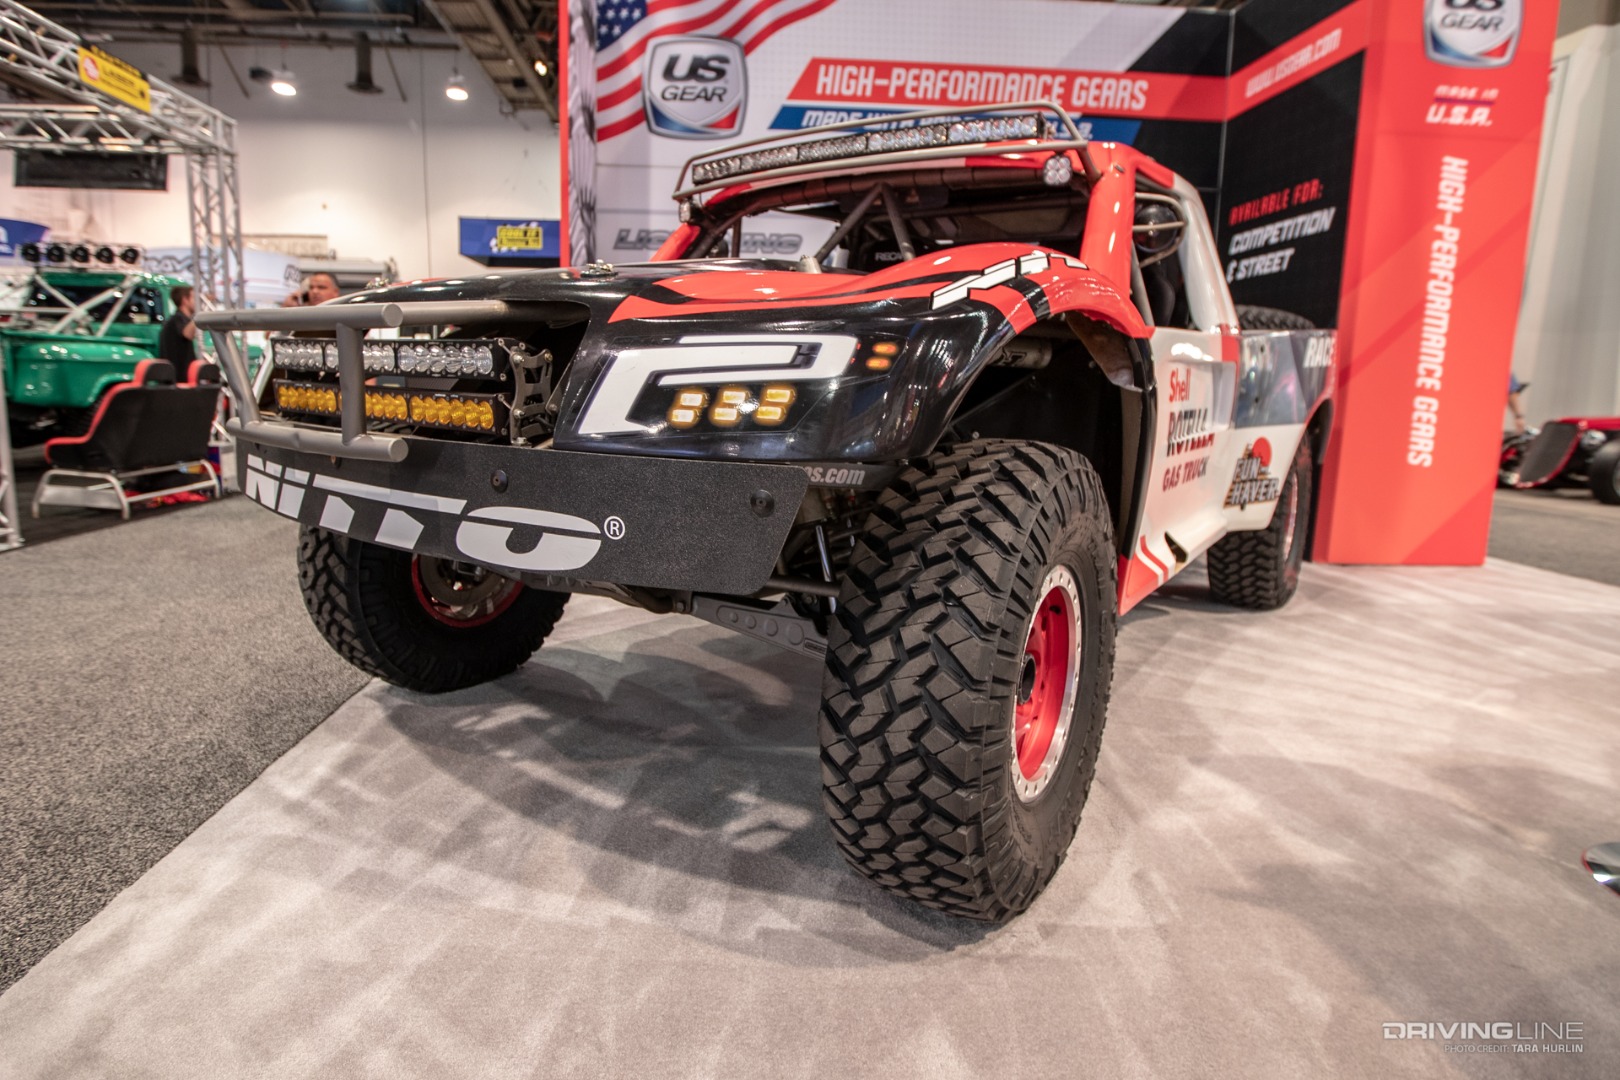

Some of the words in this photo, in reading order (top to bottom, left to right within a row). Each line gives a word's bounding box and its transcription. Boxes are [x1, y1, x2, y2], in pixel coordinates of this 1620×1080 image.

[1440, 12, 1504, 31] GEAR
[663, 54, 730, 83] US
[661, 85, 727, 102] GEAR
[816, 63, 1064, 102] HIGH-PERFORMANCE
[1072, 76, 1150, 110] GEARS
[1425, 103, 1493, 127] U.S.A.
[1228, 188, 1290, 226] AVAILABLE
[1228, 206, 1336, 256] COMPETITION
[1235, 247, 1296, 280] STREET
[1414, 155, 1468, 391] HIGH-PERFORMANCE
[1169, 367, 1191, 402] Shell
[1407, 395, 1439, 467] GEARS
[1162, 464, 1182, 492] GAS
[1182, 456, 1210, 484] TRUCK
